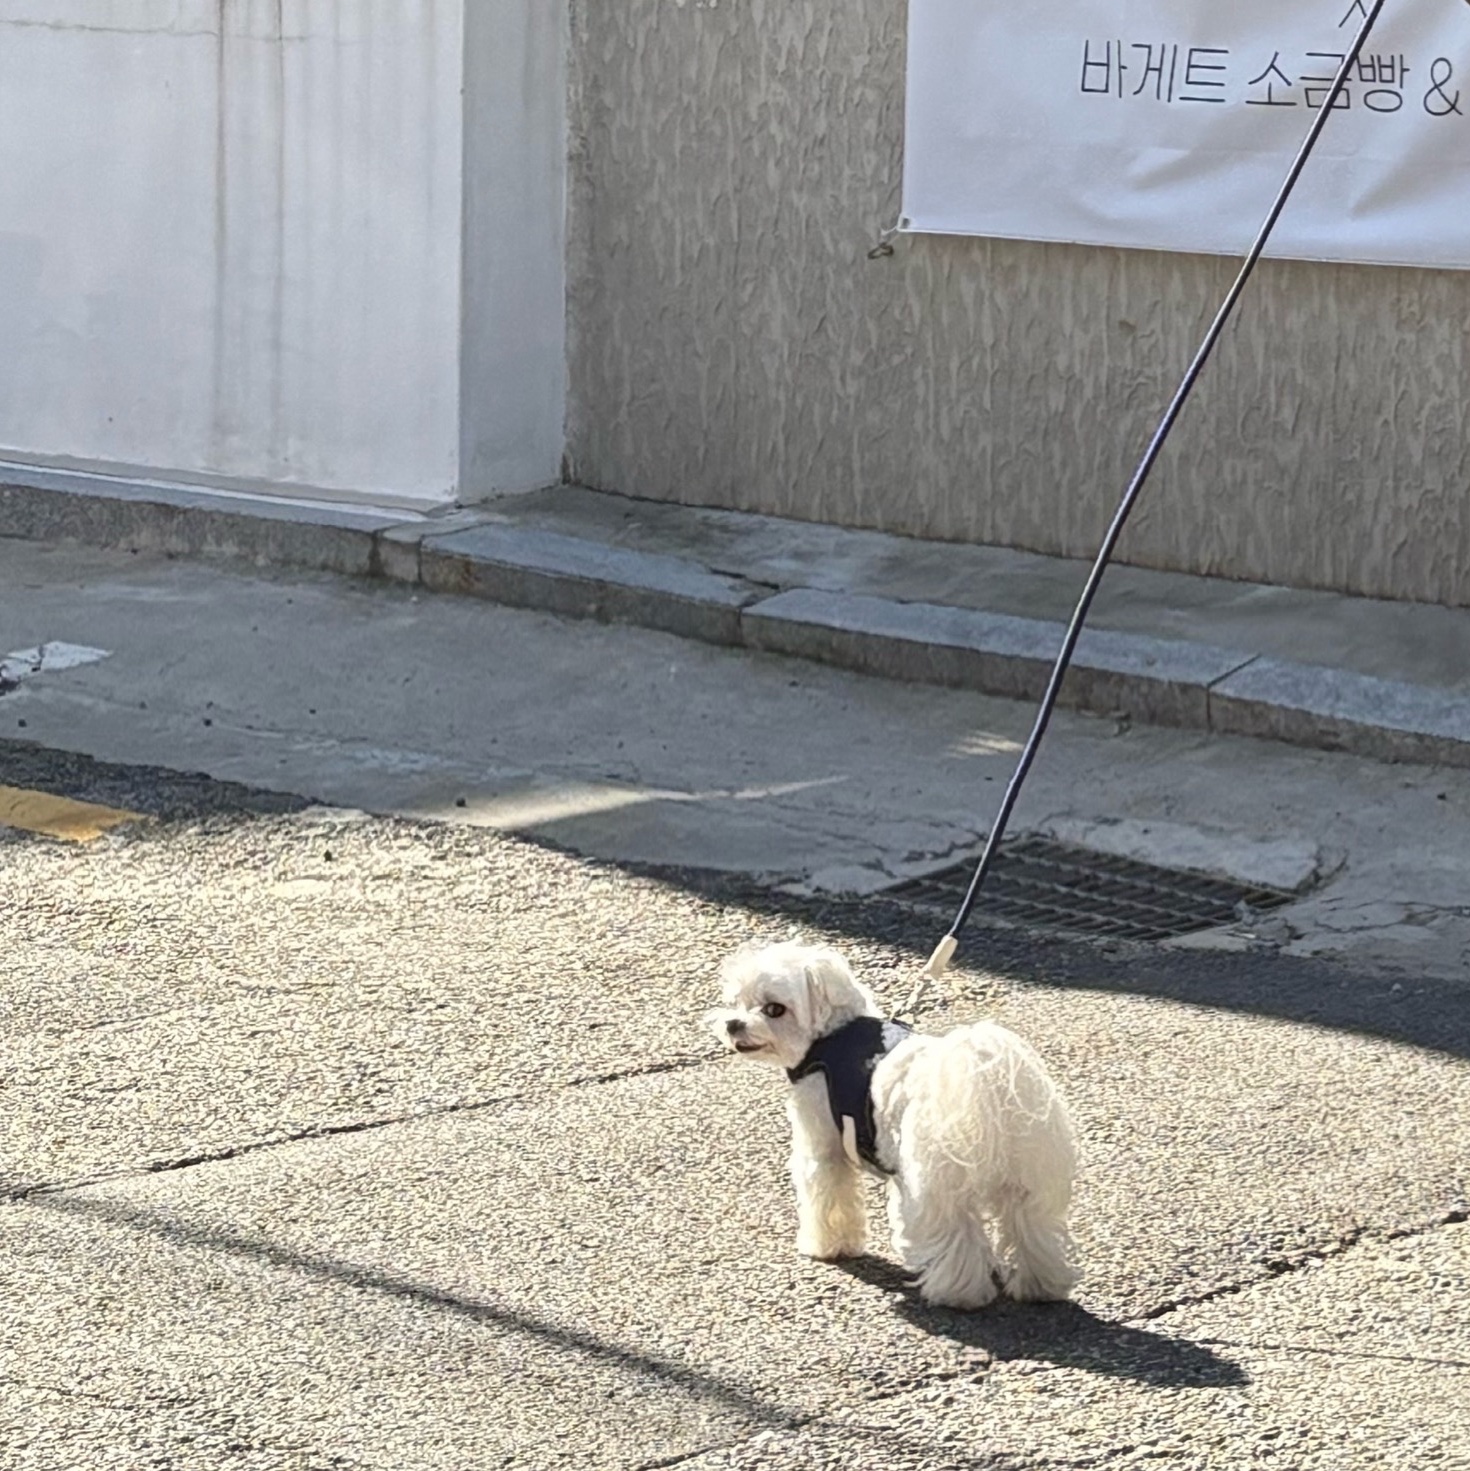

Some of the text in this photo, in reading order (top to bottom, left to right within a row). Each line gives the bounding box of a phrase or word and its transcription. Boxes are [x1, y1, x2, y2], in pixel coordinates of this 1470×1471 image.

[1080, 39, 1230, 103] 바게트
[1245, 51, 1411, 113] 소금빵
[1422, 57, 1463, 116] &
